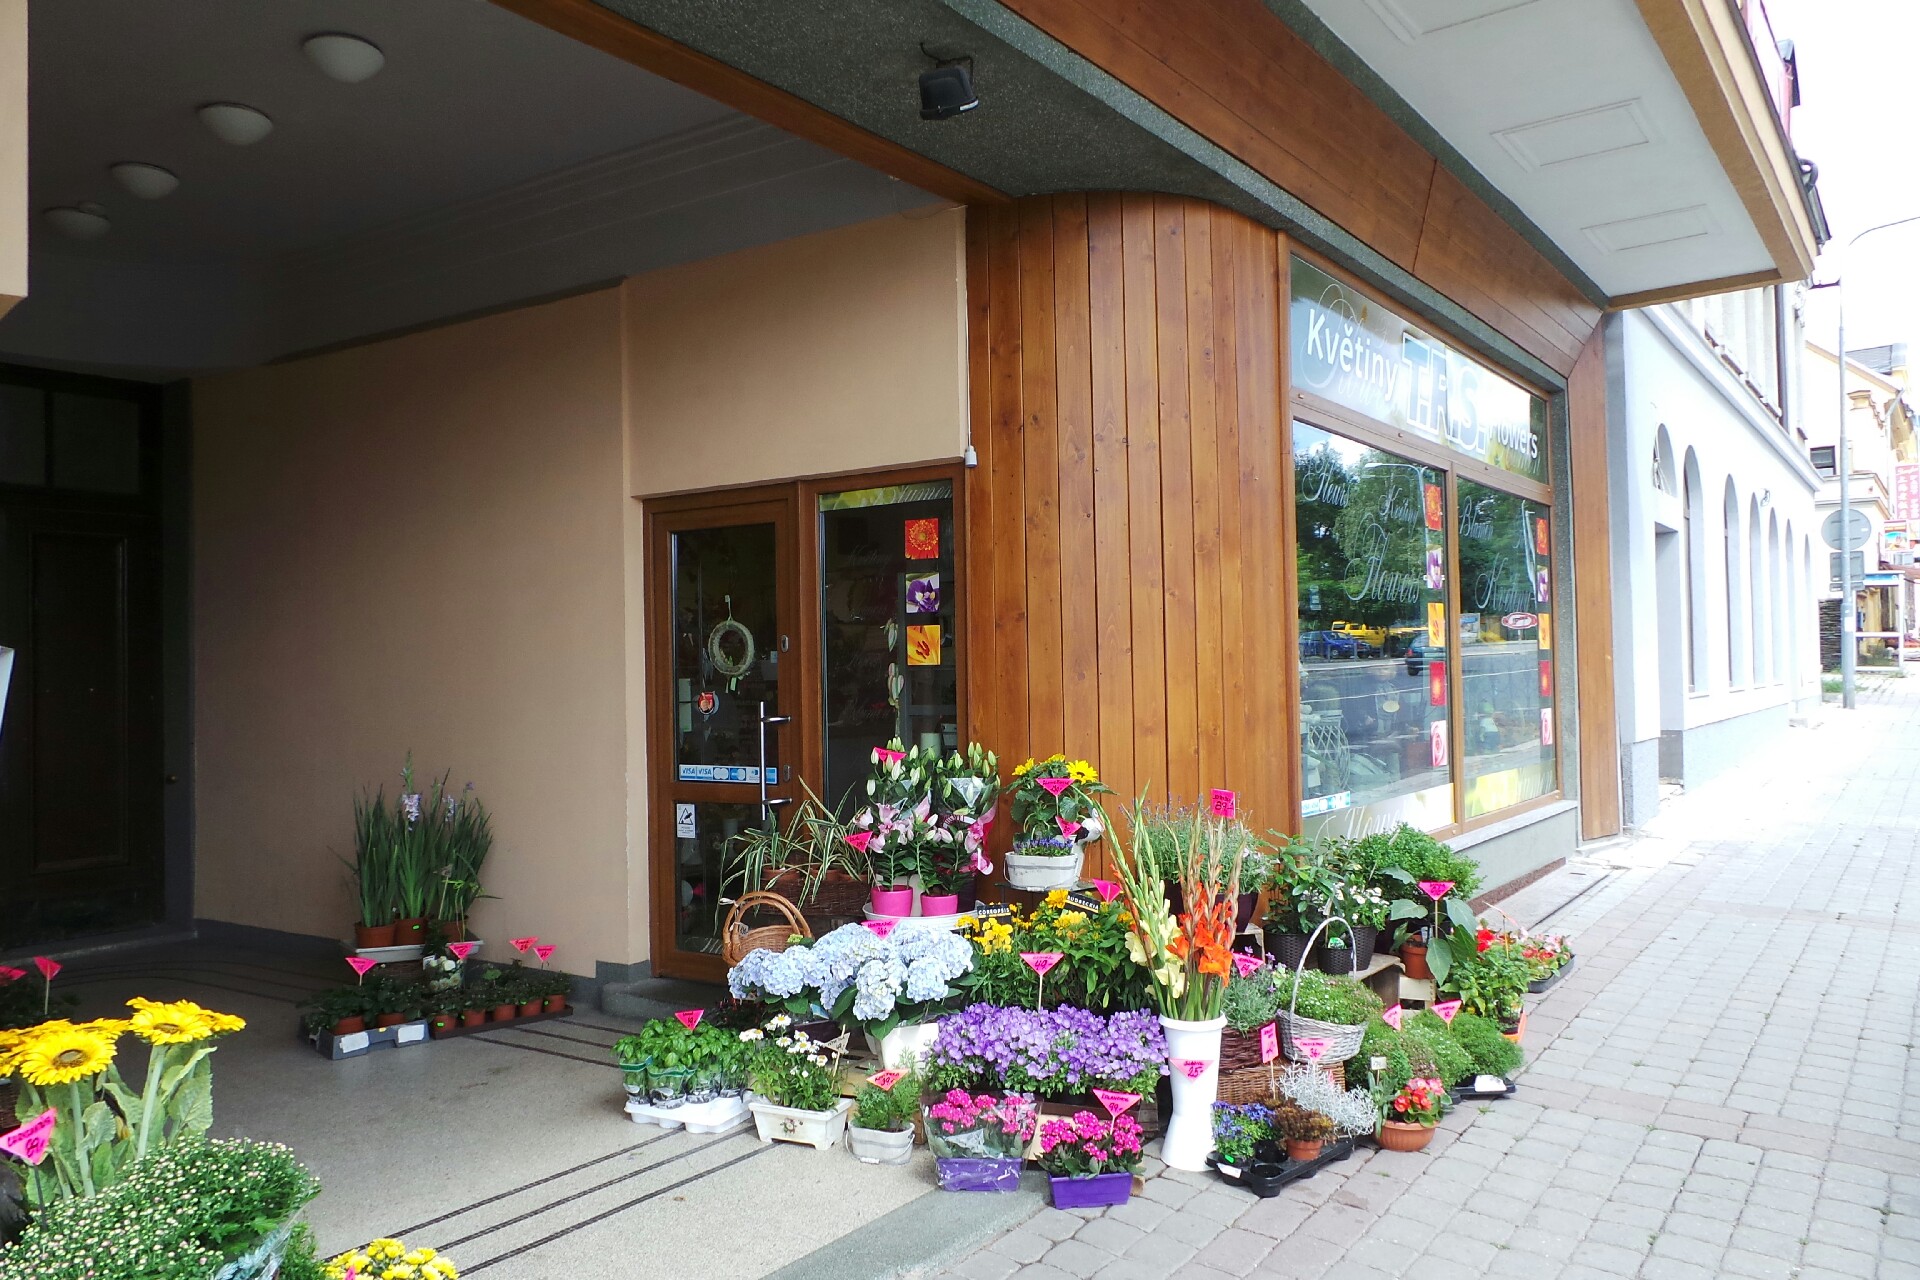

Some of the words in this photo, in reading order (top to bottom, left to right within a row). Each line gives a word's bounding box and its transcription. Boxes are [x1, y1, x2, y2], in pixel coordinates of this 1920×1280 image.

[1307, 308, 1399, 401] Květiny
[1343, 511, 1420, 604] Flowers
[682, 767, 695, 775] VISA
[699, 768, 711, 776] VISA
